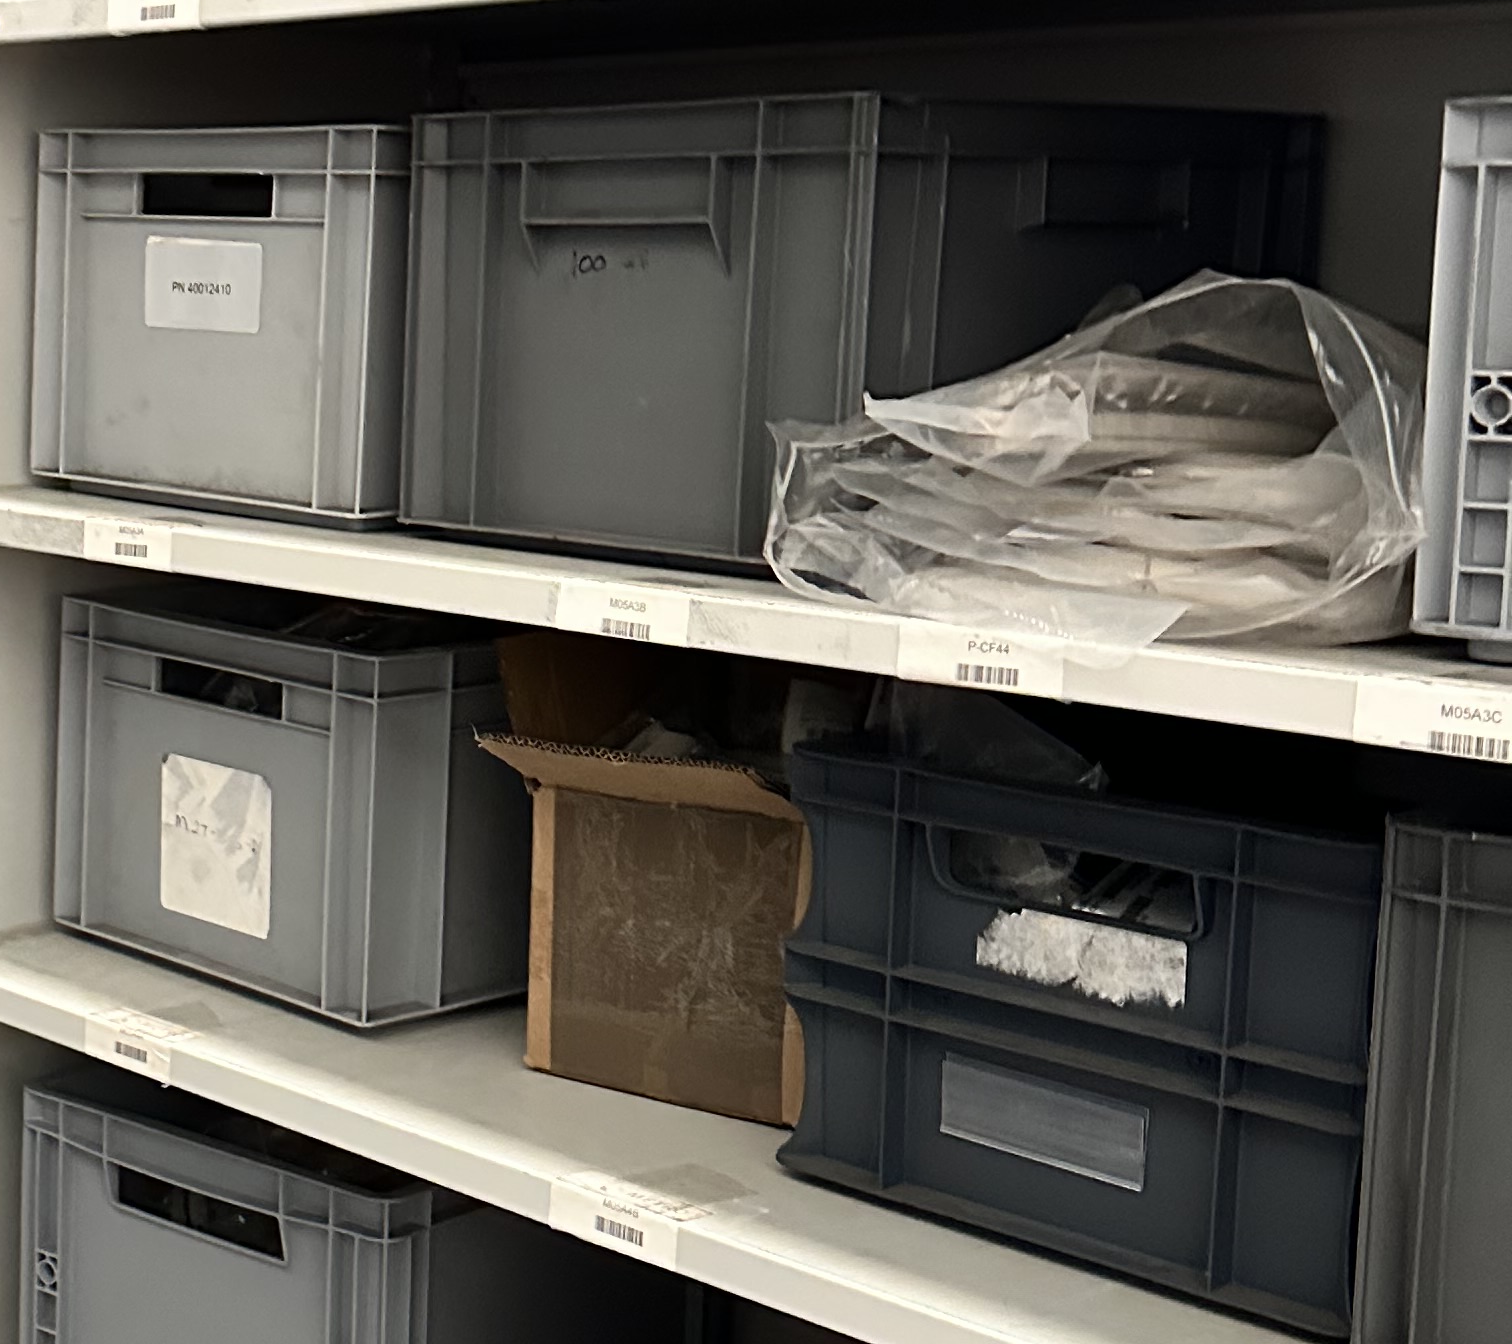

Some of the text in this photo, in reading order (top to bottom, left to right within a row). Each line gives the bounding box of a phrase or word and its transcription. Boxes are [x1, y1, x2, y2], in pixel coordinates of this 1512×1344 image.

[172, 281, 232, 296] PN 40012410
[609, 597, 647, 613] M05A3B
[967, 640, 1010, 655] P-CF44
[1440, 703, 1503, 724] M05A3C
